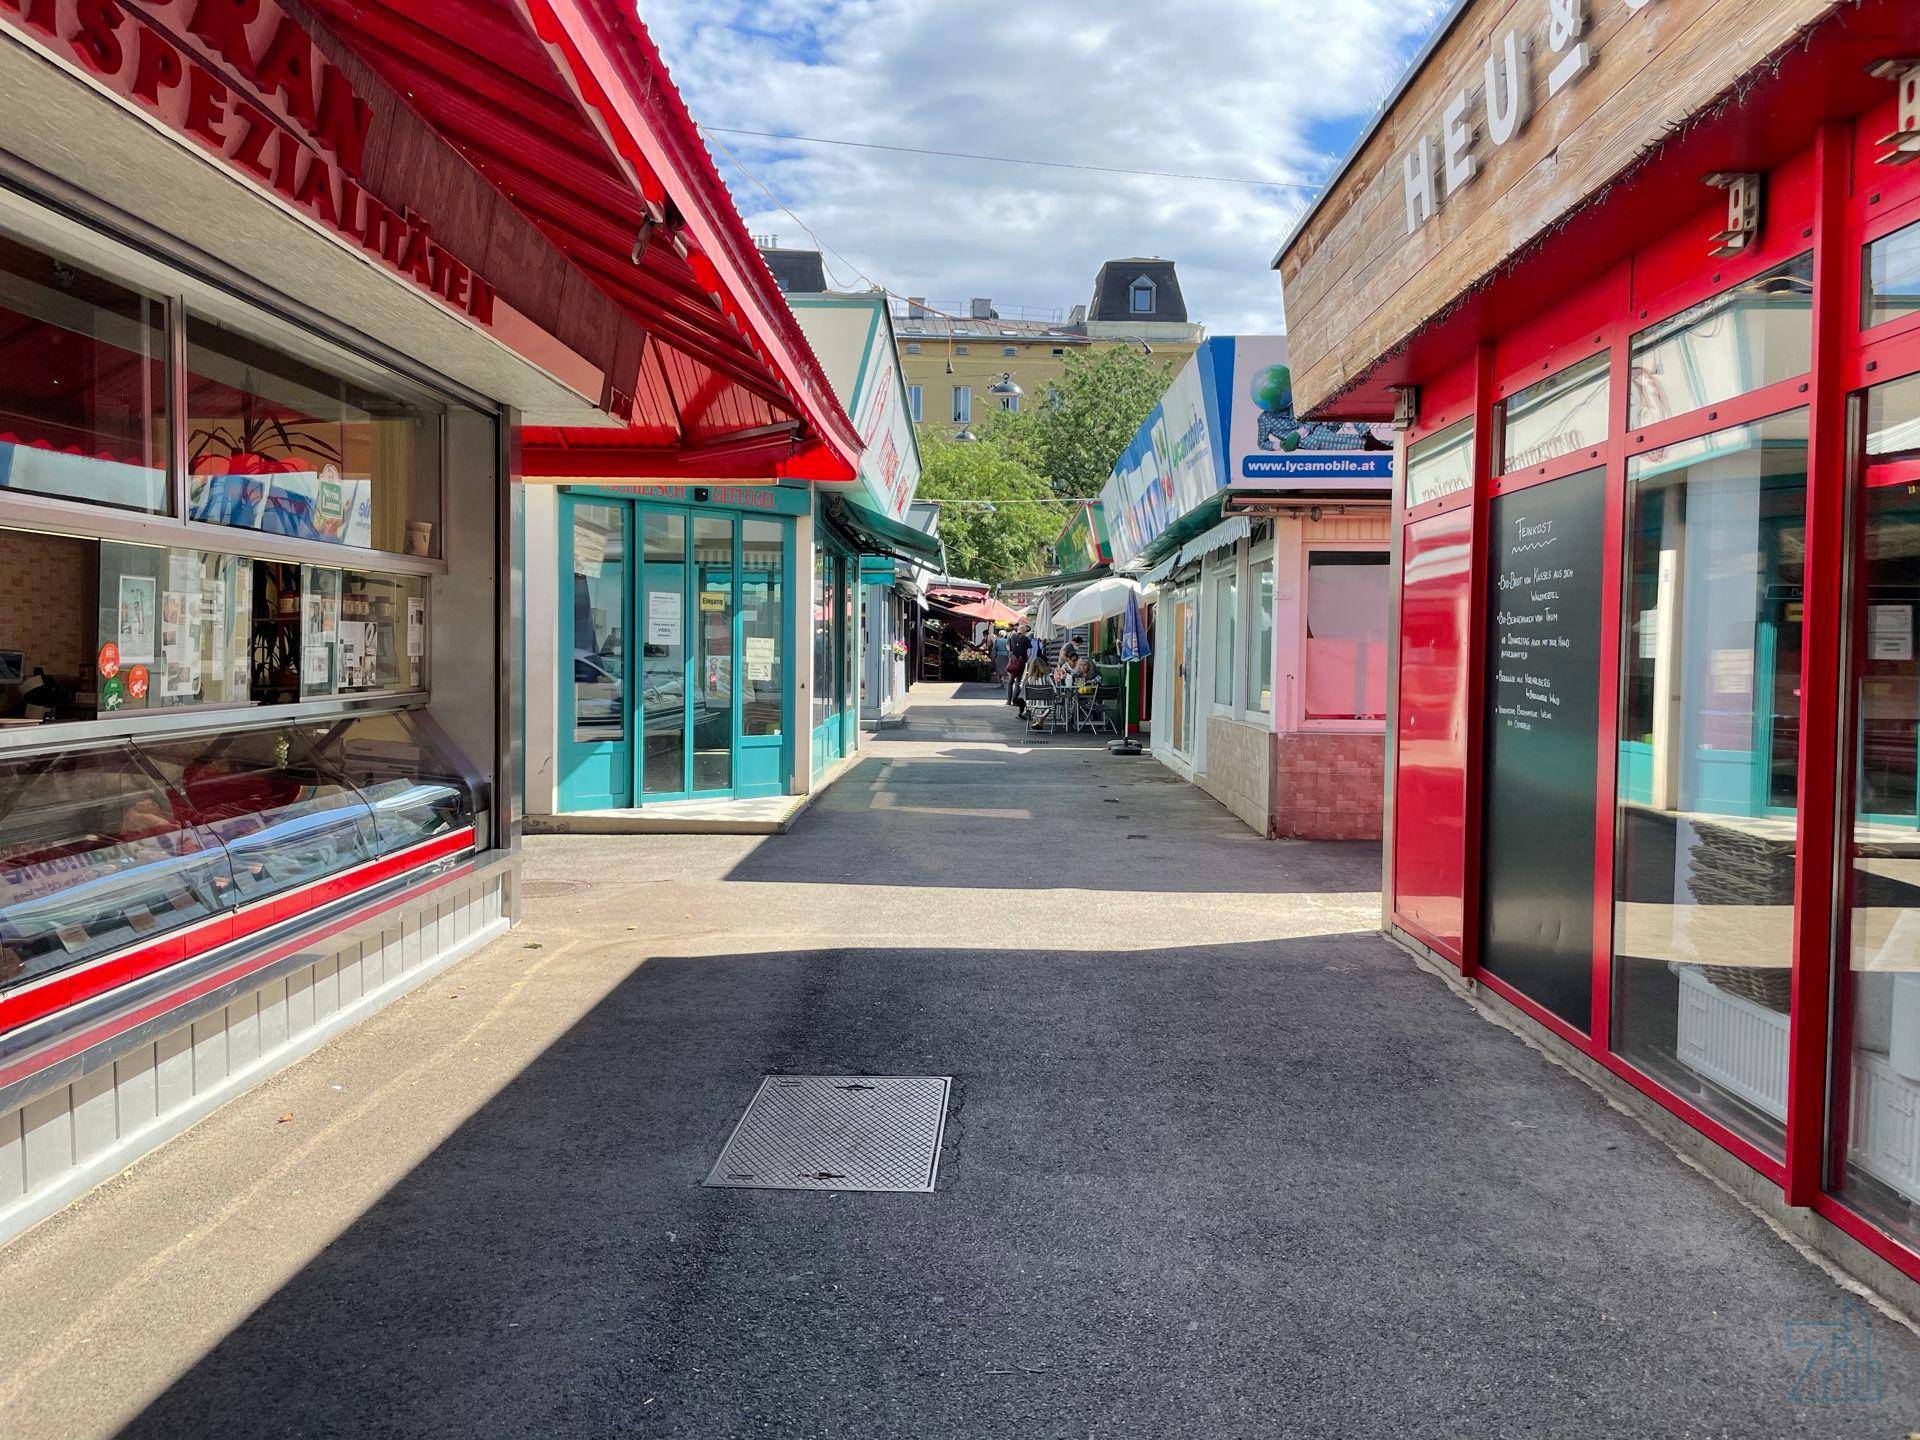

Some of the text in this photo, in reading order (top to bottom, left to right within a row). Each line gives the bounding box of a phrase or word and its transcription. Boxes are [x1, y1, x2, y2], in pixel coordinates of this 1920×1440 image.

[147, 0, 374, 182] RAN
[1402, 29, 1522, 235] HEU
[1247, 460, 1376, 473] www.lycamobile.at
[712, 486, 775, 509] GEFLÜGEL
[702, 597, 724, 607] Eingang
